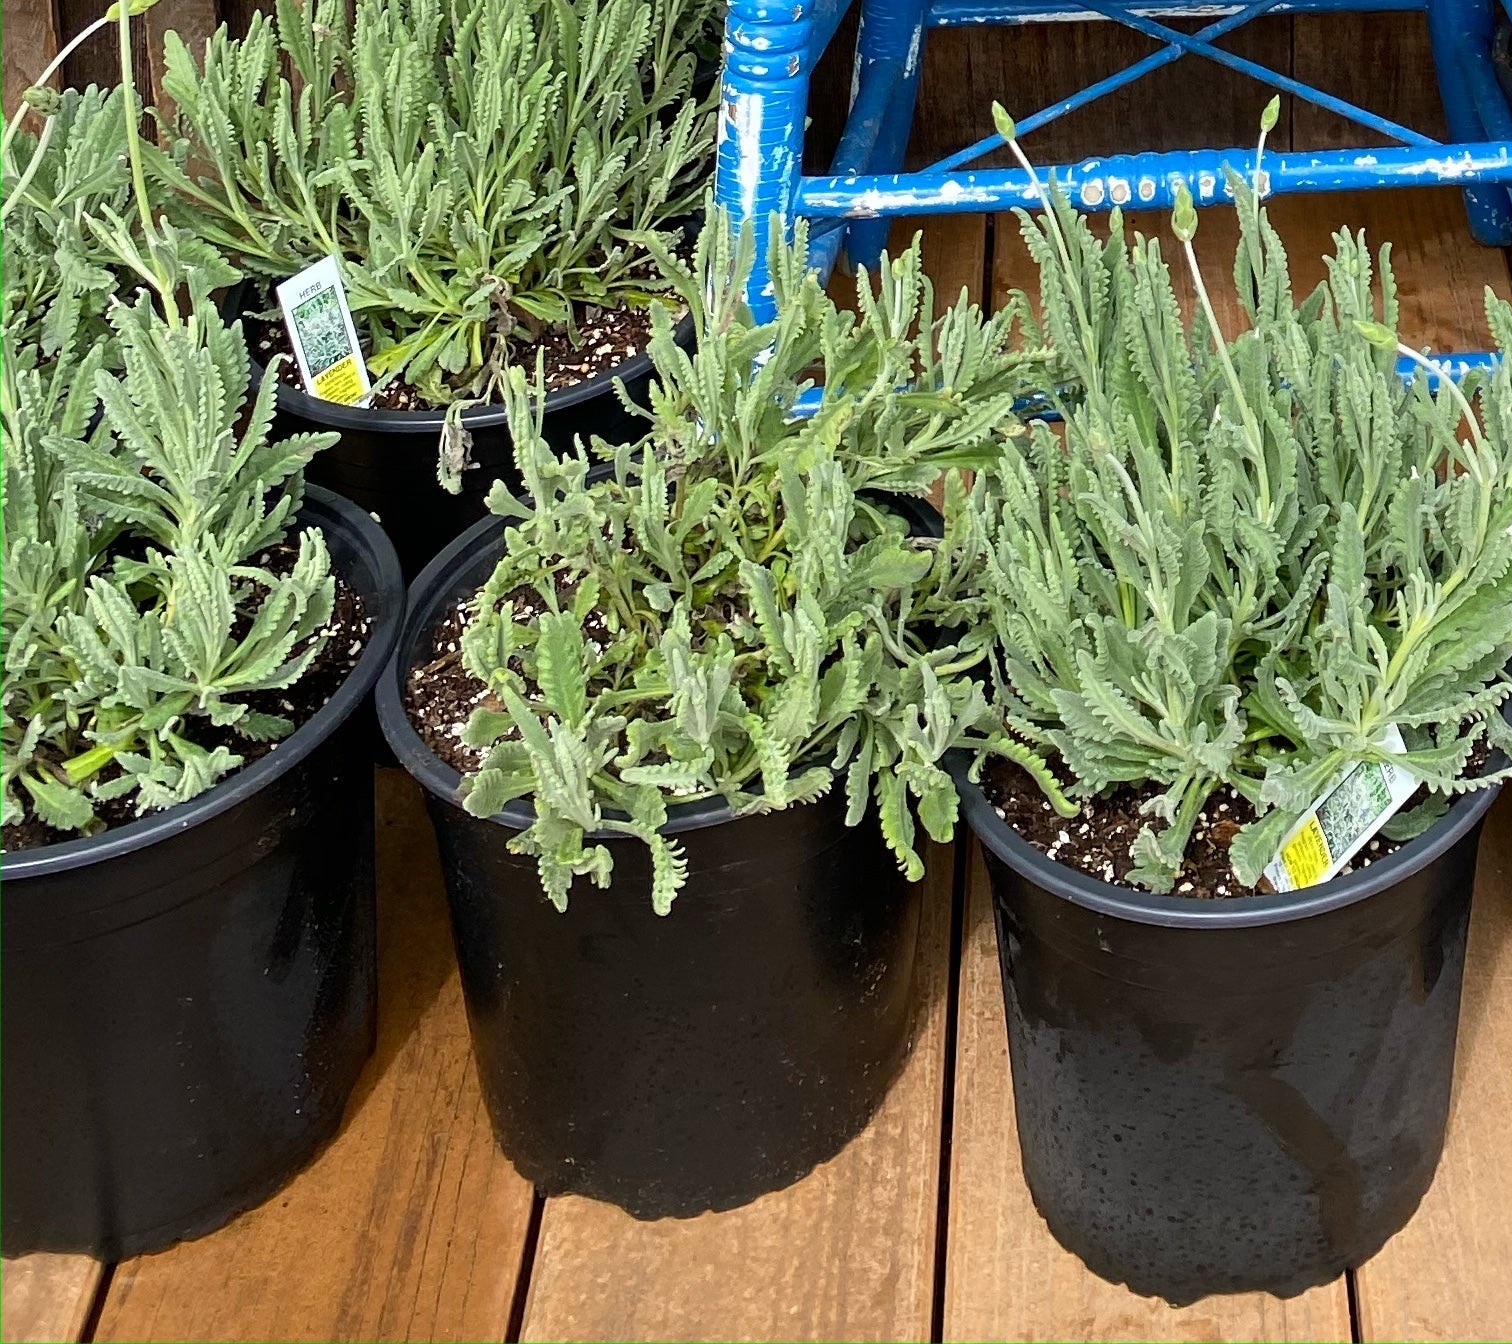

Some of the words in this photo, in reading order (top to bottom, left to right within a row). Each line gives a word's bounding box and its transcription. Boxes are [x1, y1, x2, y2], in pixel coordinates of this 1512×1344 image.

[299, 281, 322, 300] HERB
[316, 358, 352, 386] LAVENDER
[1308, 819, 1330, 867] LAVENDER
